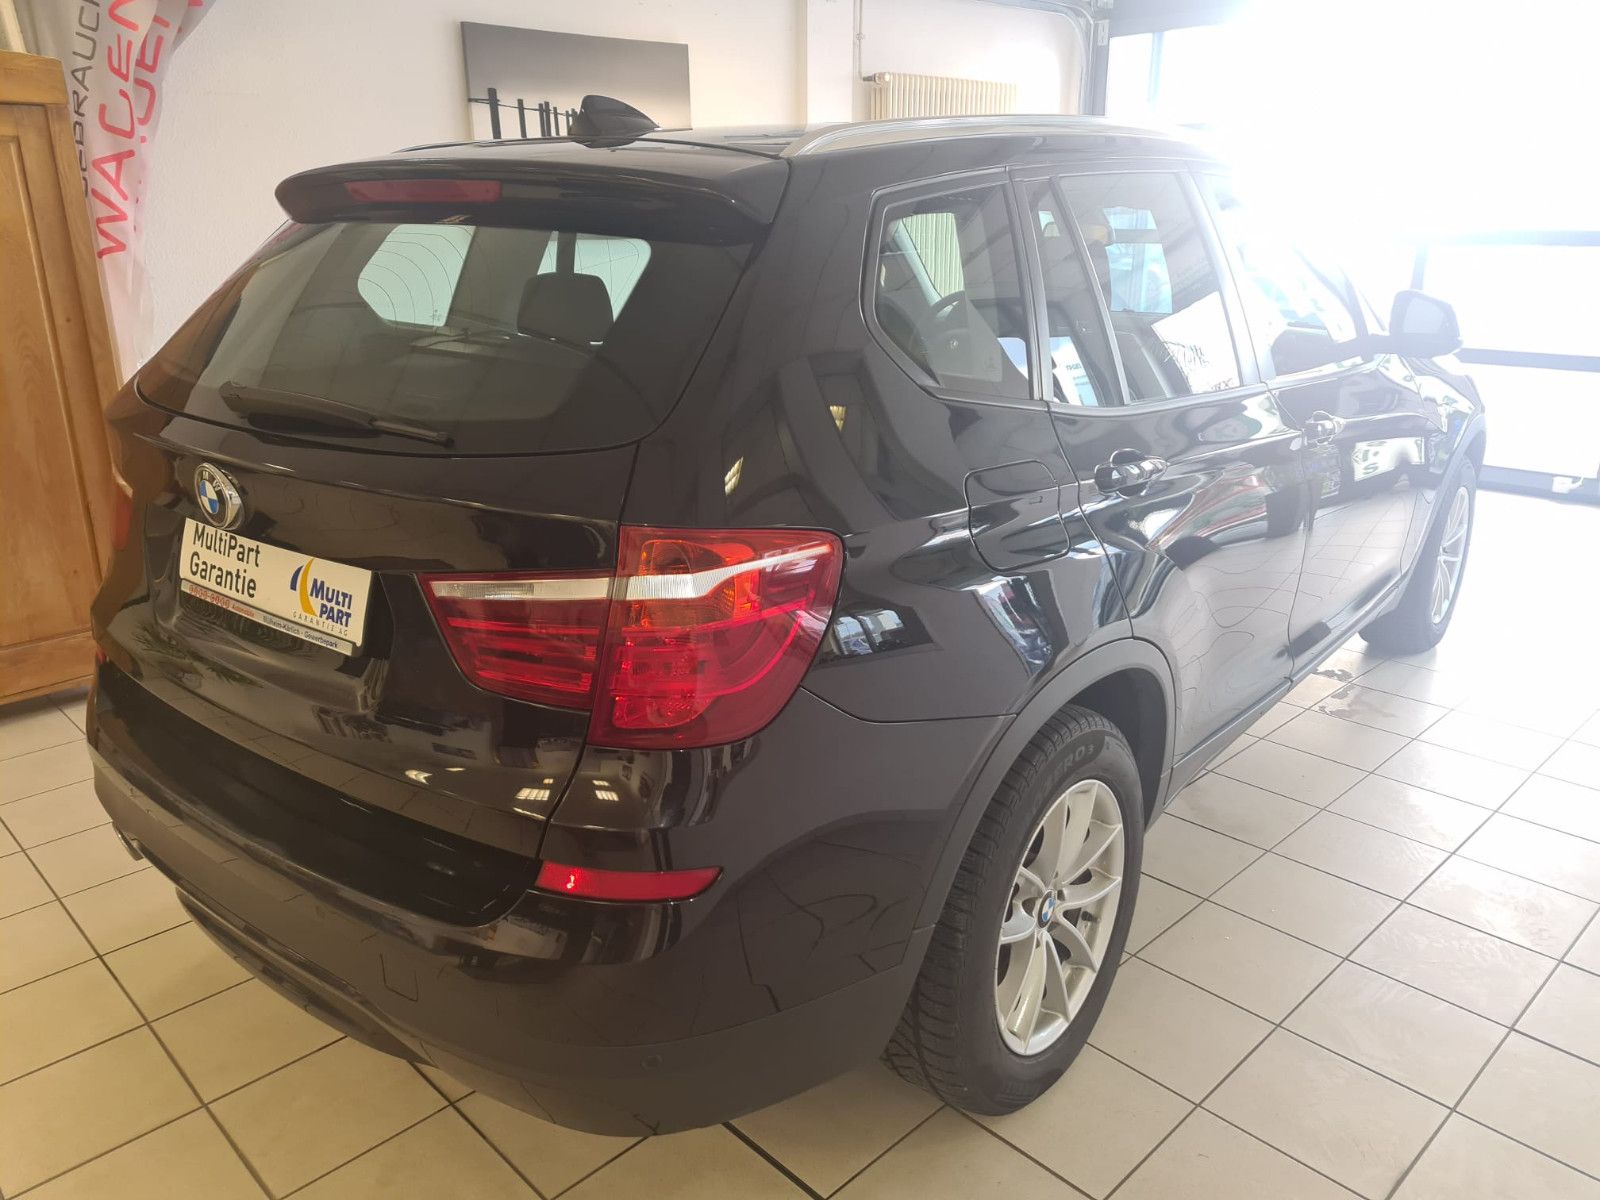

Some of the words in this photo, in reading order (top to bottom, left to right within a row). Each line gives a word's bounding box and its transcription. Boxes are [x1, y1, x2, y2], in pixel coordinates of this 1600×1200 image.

[193, 523, 260, 568] MultiPart
[190, 551, 257, 598] Garantie
[292, 610, 336, 632] GARANTIE
[338, 628, 349, 637] AG
[319, 602, 352, 628] PART
